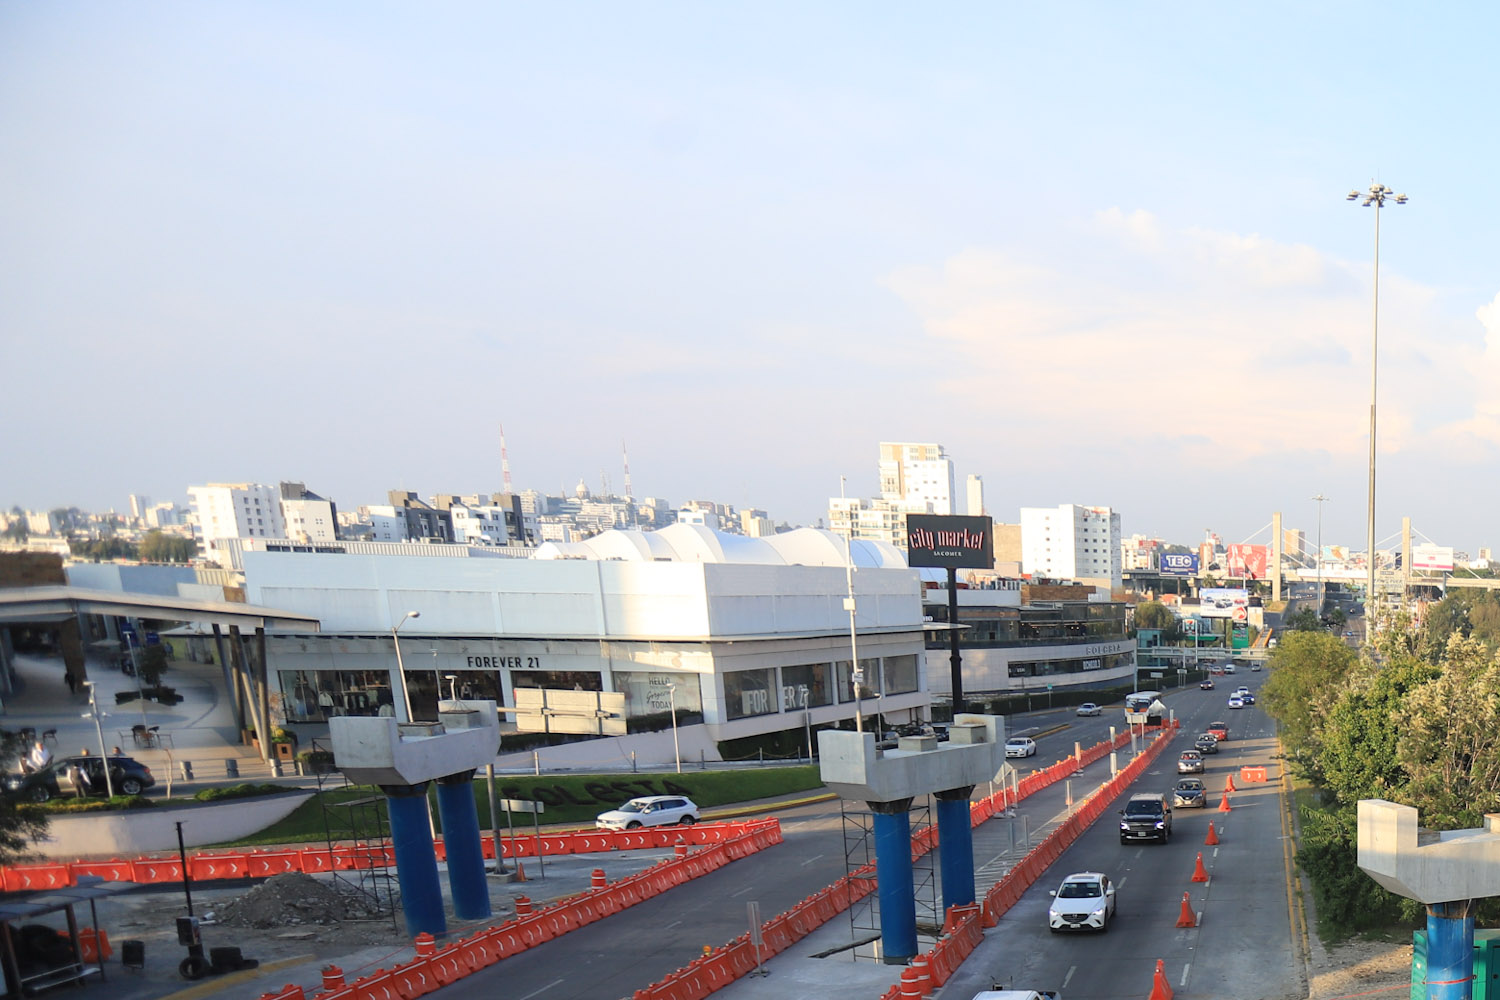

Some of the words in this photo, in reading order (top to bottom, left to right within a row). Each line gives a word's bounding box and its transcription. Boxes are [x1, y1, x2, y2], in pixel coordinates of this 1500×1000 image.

[909, 528, 935, 550] city
[937, 527, 984, 551] market
[1166, 555, 1192, 567] TEC
[467, 656, 522, 668] FOREVER
[528, 657, 540, 668] 21
[648, 677, 671, 686] HELLO
